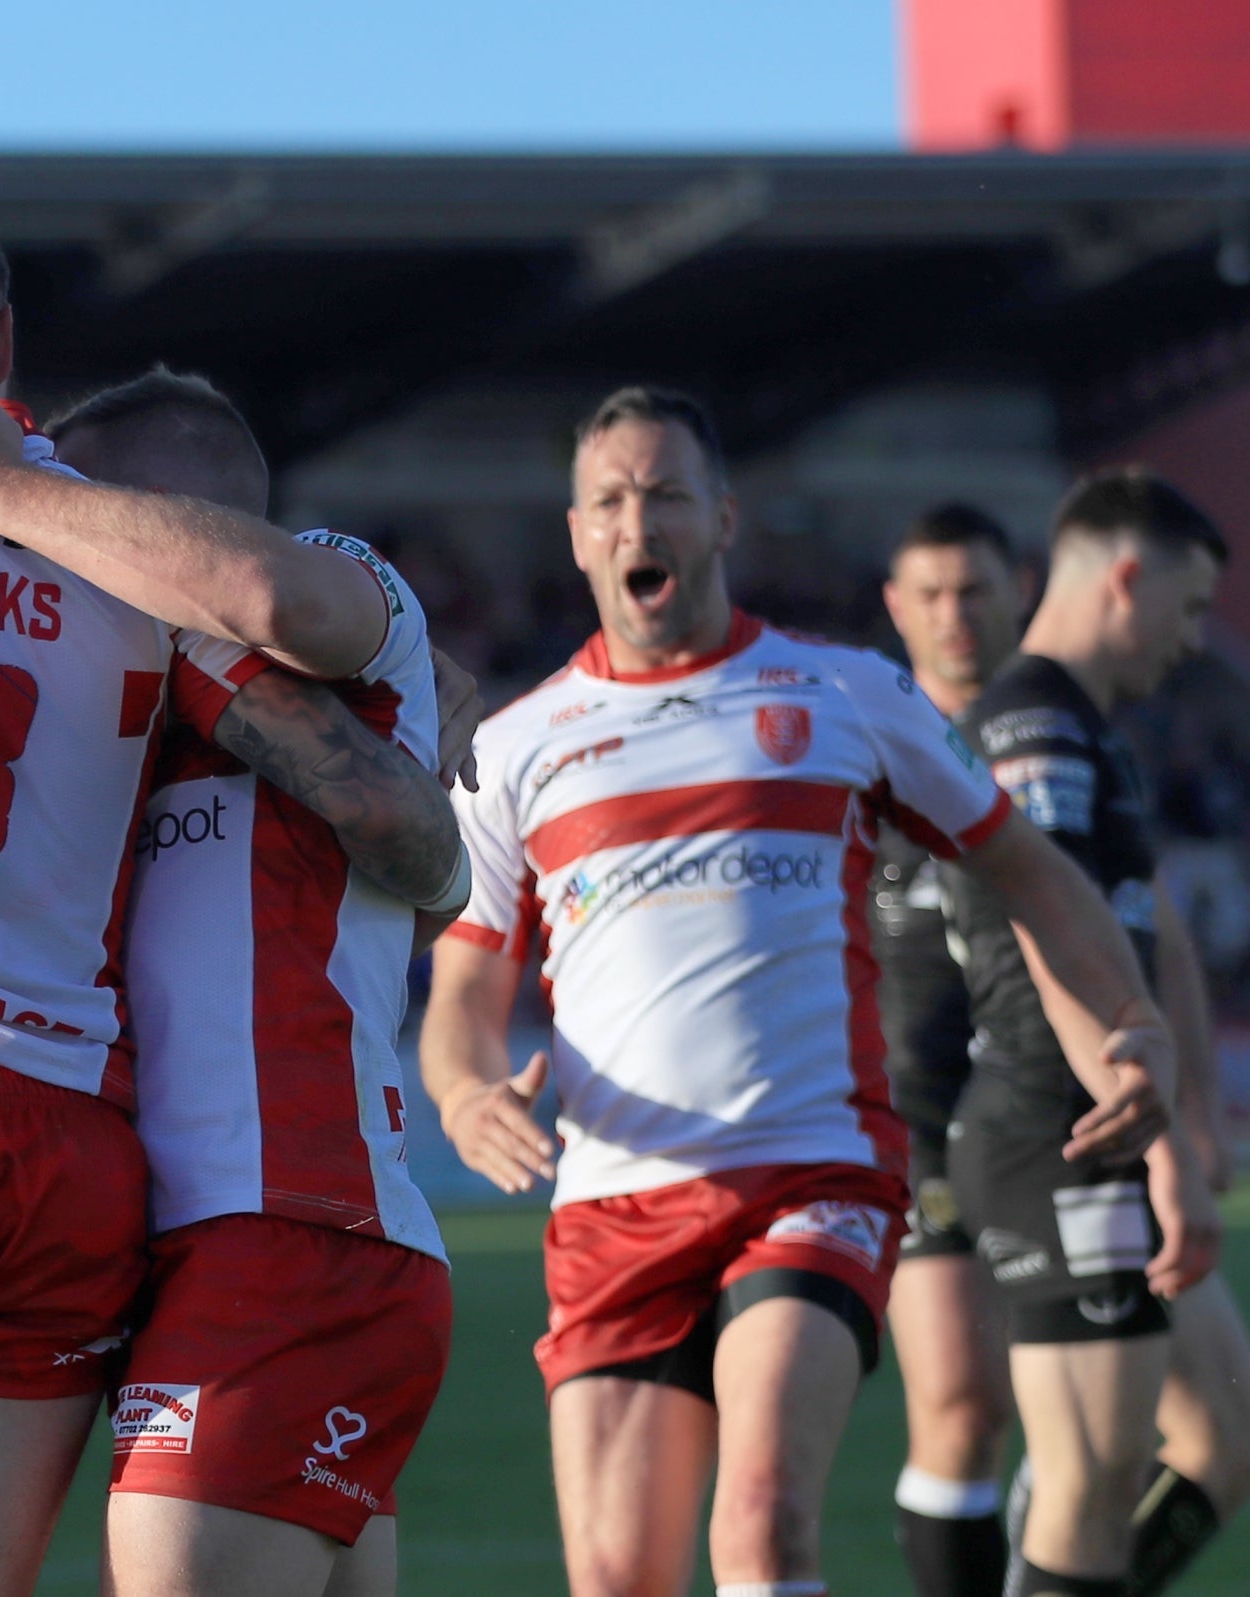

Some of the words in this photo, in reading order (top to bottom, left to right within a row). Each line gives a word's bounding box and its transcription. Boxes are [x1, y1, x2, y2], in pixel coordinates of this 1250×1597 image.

[126, 1386, 194, 1423] LEAMING
[163, 1440, 185, 1449] HIRE
[301, 1457, 337, 1489] Spire
[334, 1477, 359, 1500] Hull
